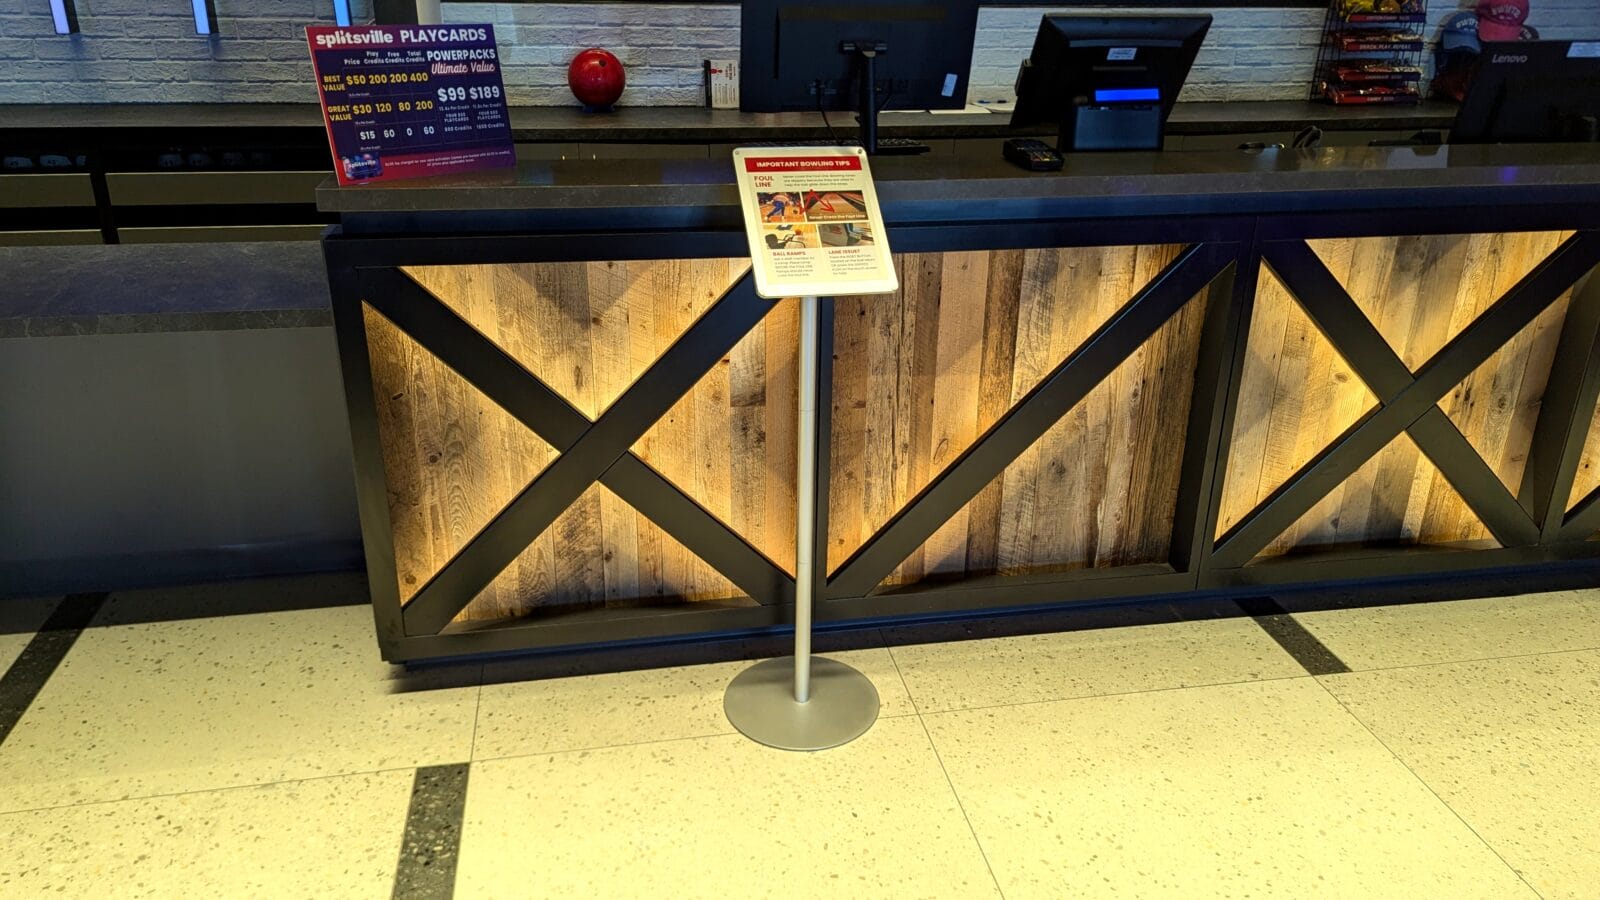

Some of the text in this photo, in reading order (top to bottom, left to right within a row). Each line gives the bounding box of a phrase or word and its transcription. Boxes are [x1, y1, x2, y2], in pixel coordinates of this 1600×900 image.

[316, 28, 487, 48] splitsville PLAYCARDS
[427, 48, 496, 61] POWERPACKS
[1492, 54, 1528, 63] Lenovo
[431, 61, 495, 74] Ultimate Value
[324, 75, 341, 83] BEST
[346, 72, 428, 85] $50 200 200 400
[323, 83, 346, 91] VALUE
[469, 85, 500, 99] $189
[438, 86, 466, 102] $99
[328, 105, 350, 113] GREAT
[352, 101, 433, 115] $30 120 80 200
[330, 113, 352, 121] VALUE
[360, 126, 435, 140] $15 60 0 60
